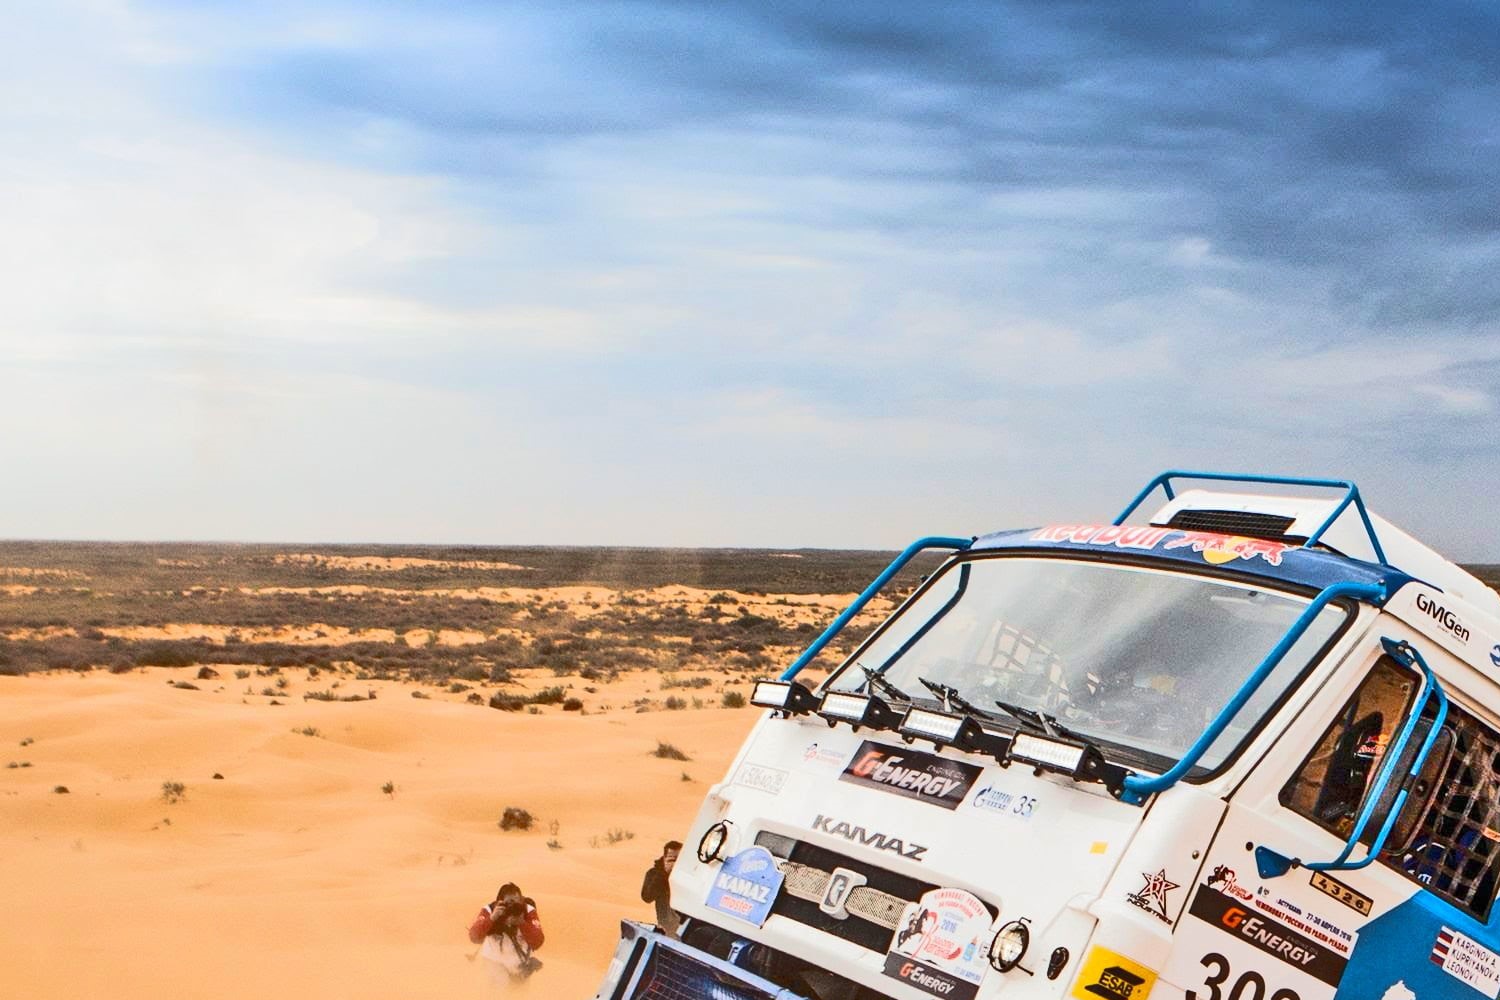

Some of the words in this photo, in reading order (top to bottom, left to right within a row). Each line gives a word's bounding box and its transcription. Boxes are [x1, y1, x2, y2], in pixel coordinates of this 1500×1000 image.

[1416, 593, 1470, 642] GMGen
[811, 814, 929, 862] KAMAZ
[716, 873, 773, 904] KAMAZ
[1451, 948, 1493, 979] KUPRIYANOV
[1456, 937, 1490, 963] KARGINOV
[1098, 971, 1134, 998] ESAB
[1446, 960, 1474, 982] LEONOV
